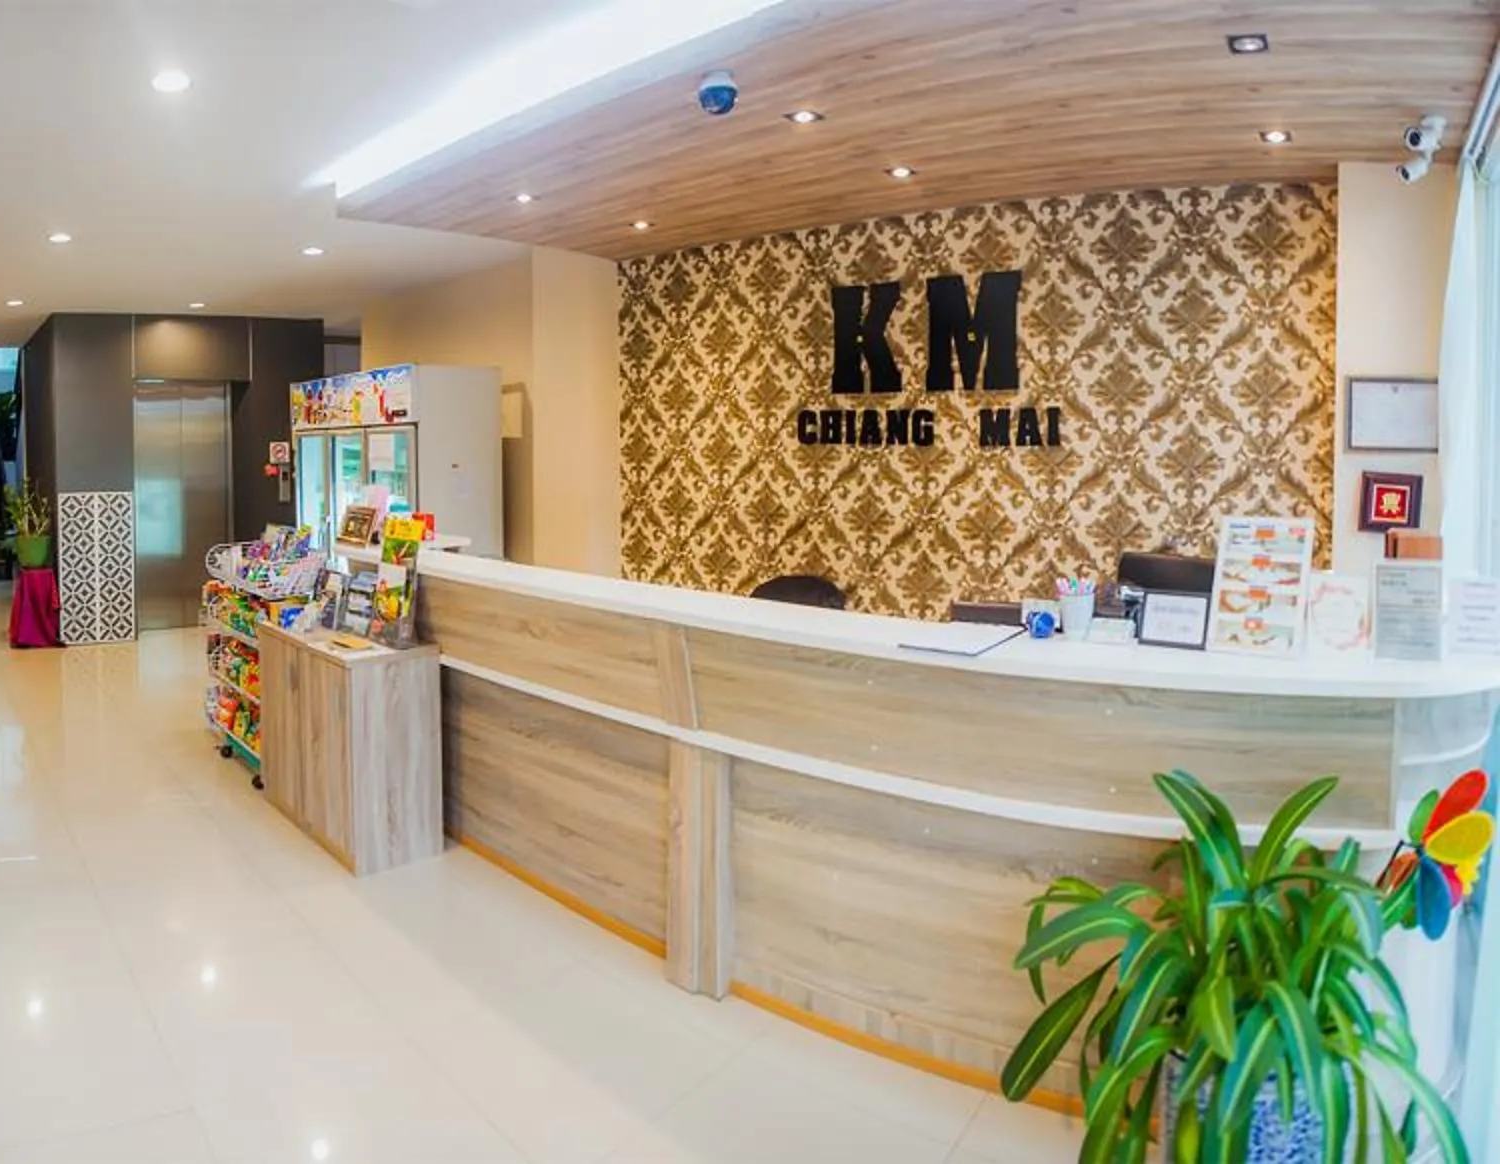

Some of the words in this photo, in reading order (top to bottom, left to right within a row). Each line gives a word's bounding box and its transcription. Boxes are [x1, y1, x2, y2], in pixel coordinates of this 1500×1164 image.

[832, 271, 1021, 393] KM
[797, 409, 934, 446] CHIANG
[979, 407, 1060, 446] MAI
